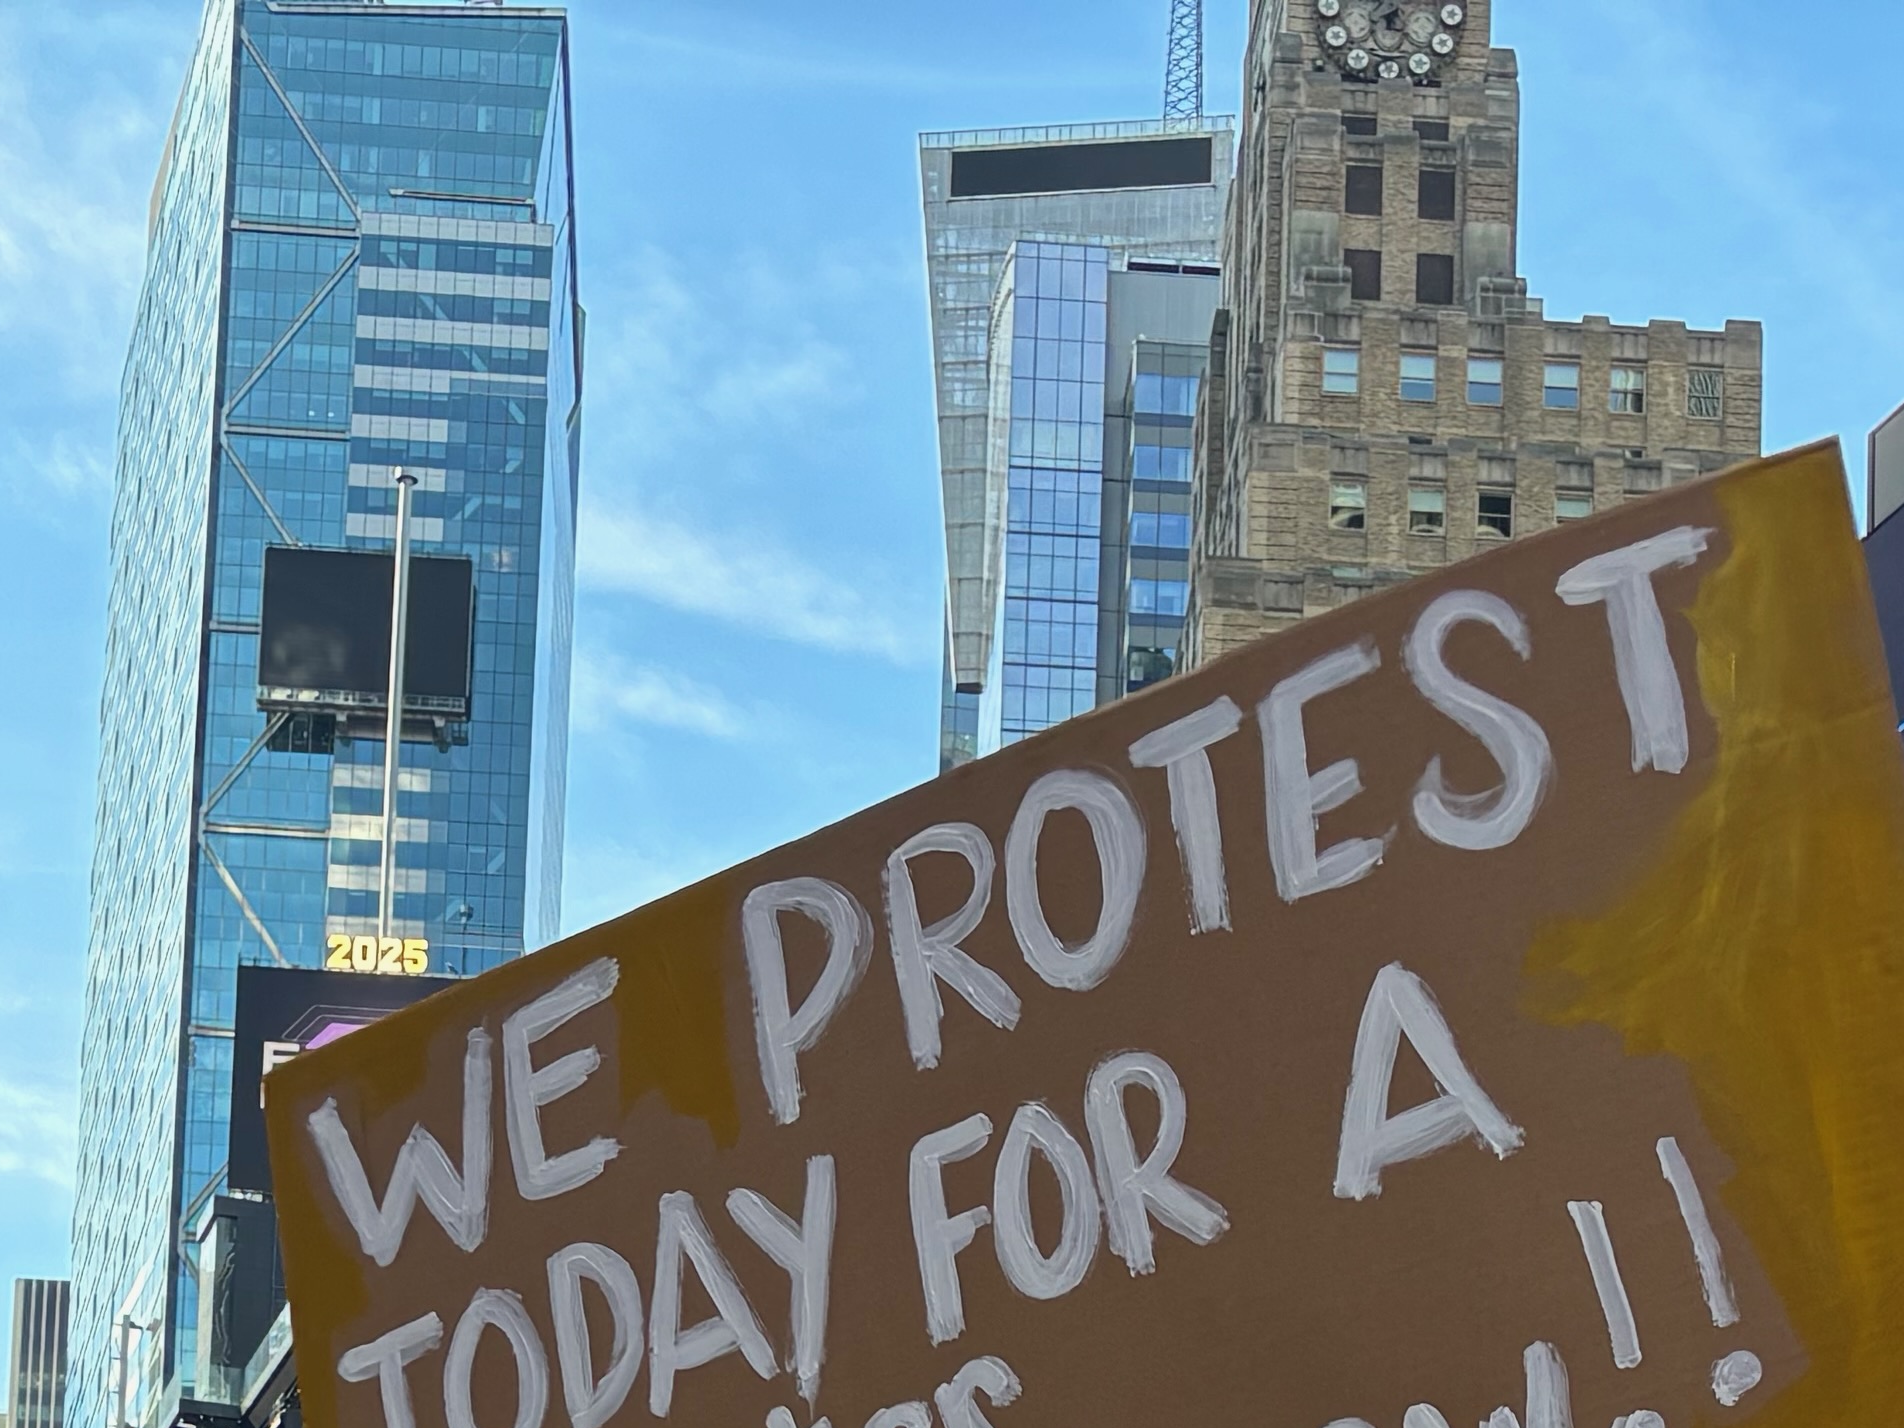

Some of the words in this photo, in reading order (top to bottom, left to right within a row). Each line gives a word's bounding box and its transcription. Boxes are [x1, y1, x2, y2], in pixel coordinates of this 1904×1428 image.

[307, 956, 622, 1270] WE
[740, 525, 1718, 1127] PROTEST
[326, 934, 429, 975] 2025
[908, 1047, 1232, 1346] FOR
[1330, 959, 1527, 1202] A
